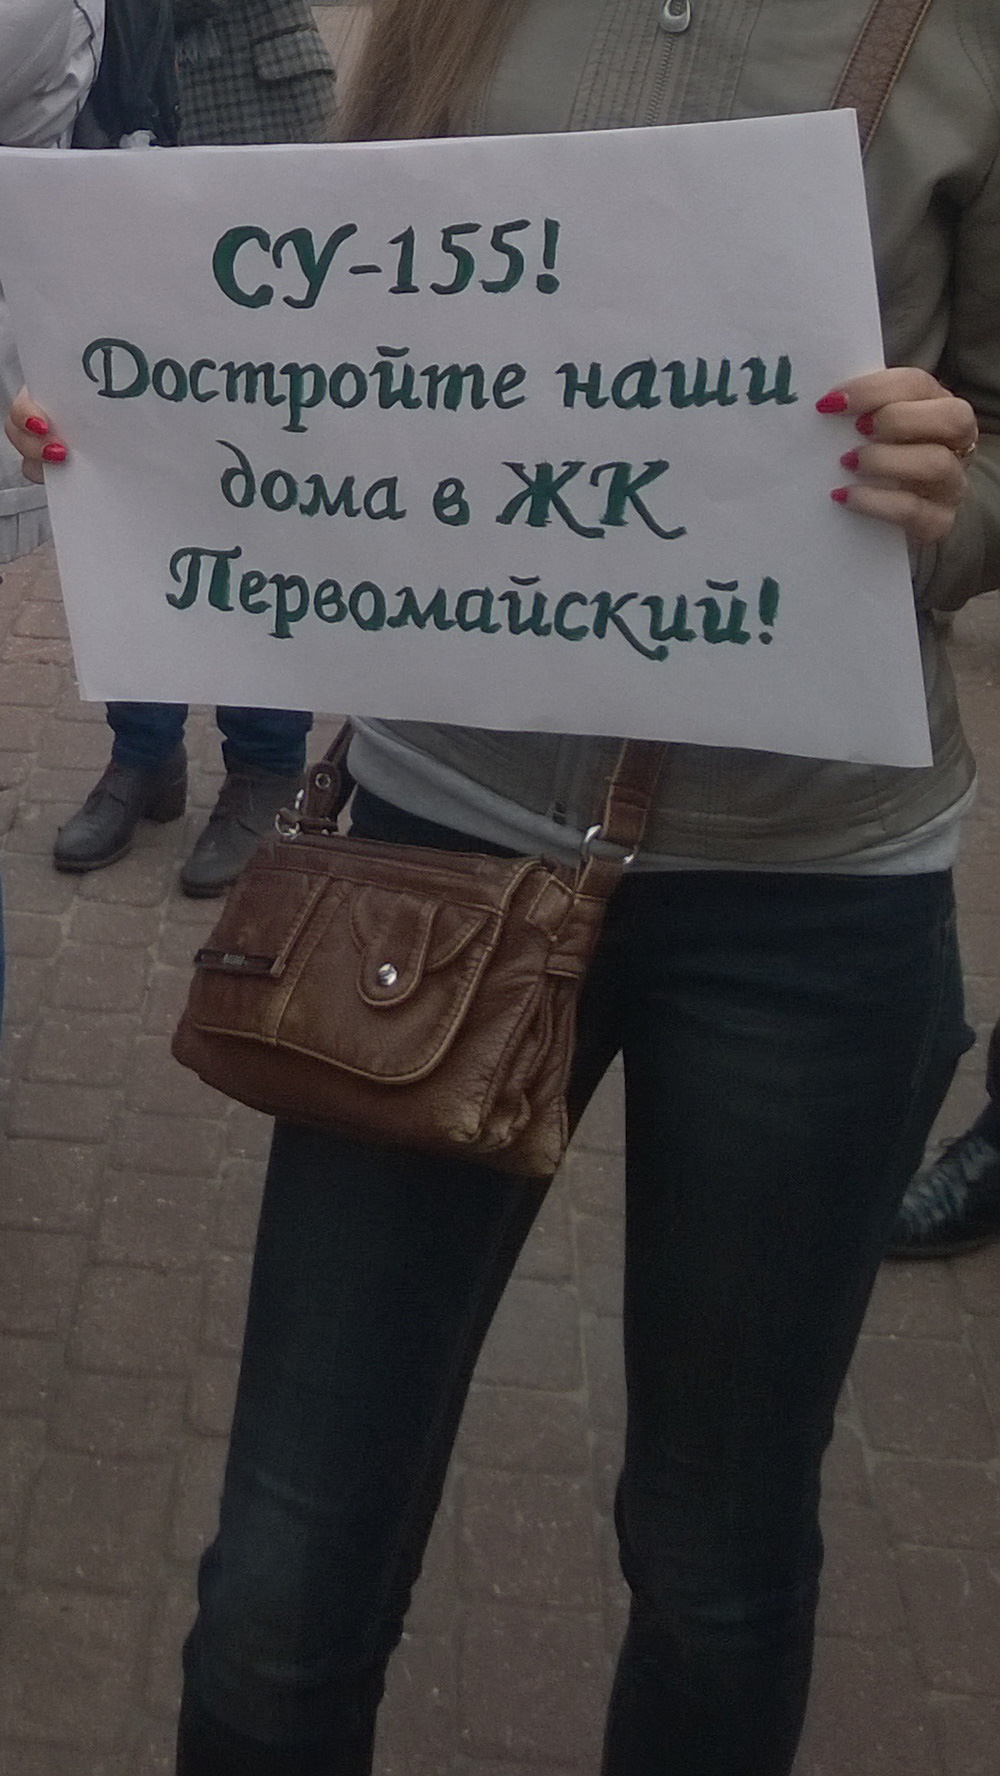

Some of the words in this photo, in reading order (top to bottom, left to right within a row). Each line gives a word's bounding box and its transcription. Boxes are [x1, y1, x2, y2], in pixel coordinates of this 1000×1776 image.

[212, 217, 559, 310] СУ-155!
[82, 337, 526, 433] Достройте
[555, 355, 798, 409] наши
[216, 439, 406, 521] дома
[432, 476, 470, 527] в
[495, 459, 686, 540] ЖК
[165, 545, 780, 662] Первомайский!
